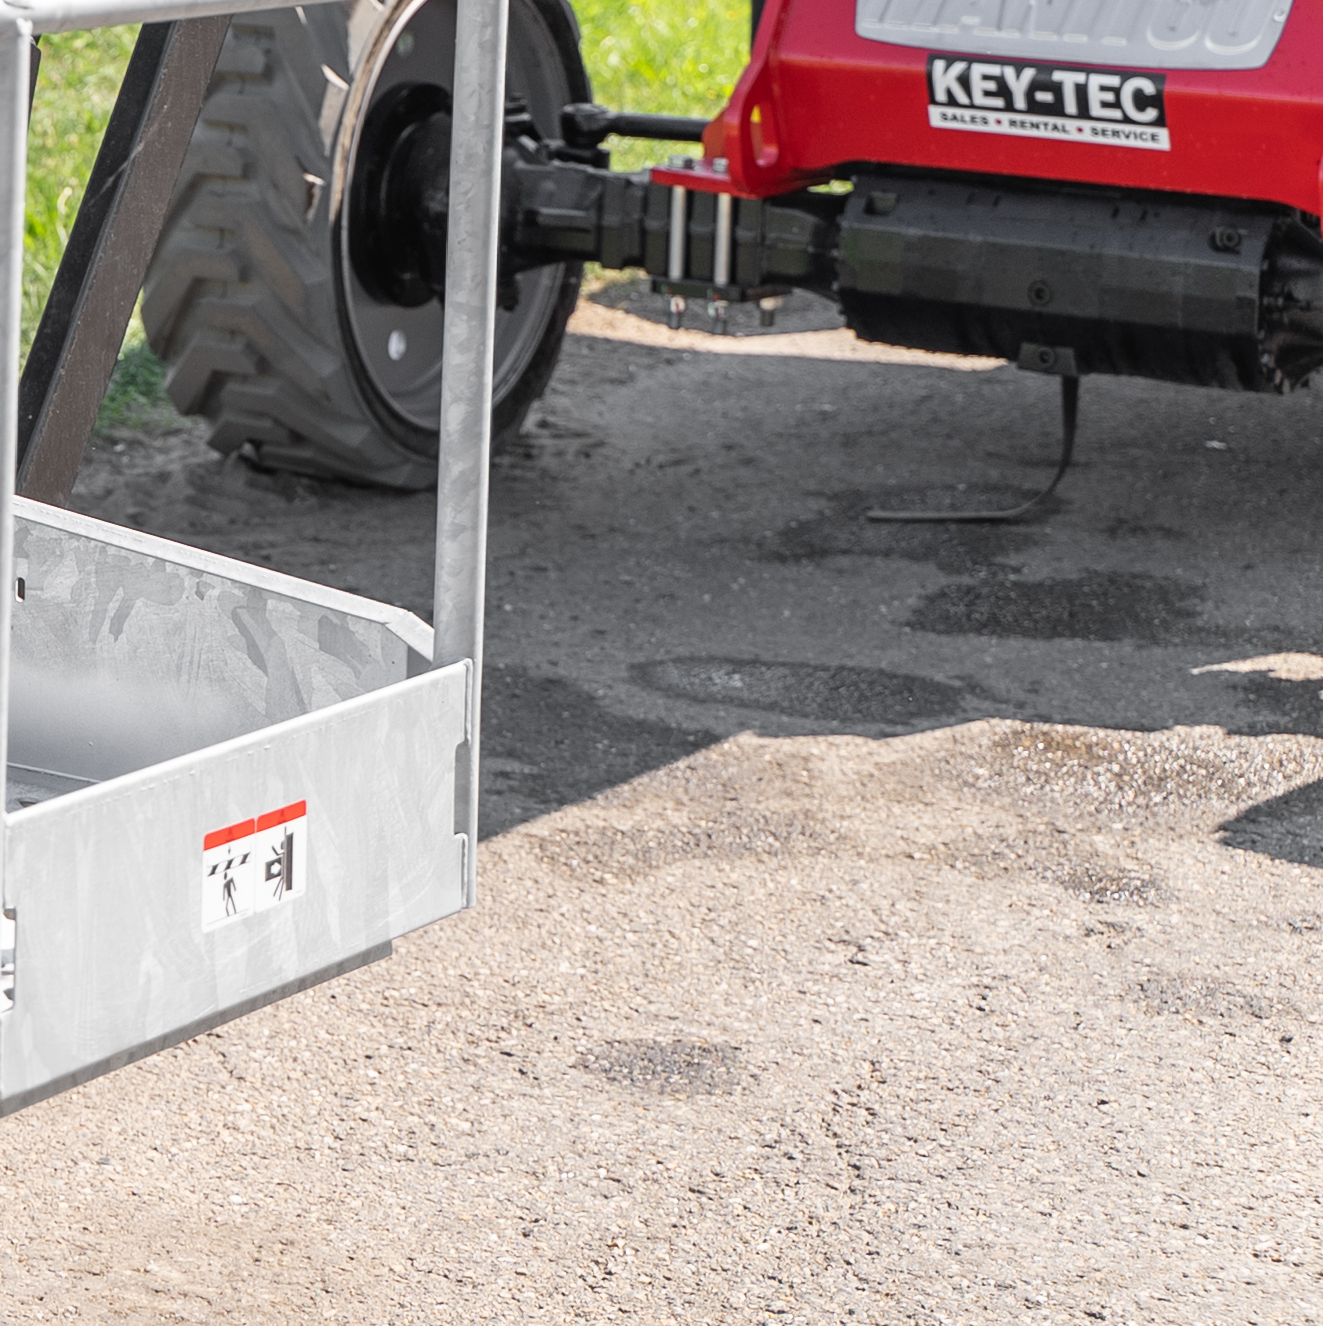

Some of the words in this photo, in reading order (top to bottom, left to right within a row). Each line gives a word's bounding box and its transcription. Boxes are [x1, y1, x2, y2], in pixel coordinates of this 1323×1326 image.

[931, 59, 1160, 123] KEY-TEC
[939, 111, 989, 125] SALES
[1009, 118, 1071, 134] RENTAL
[1090, 127, 1160, 143] SERVICE
